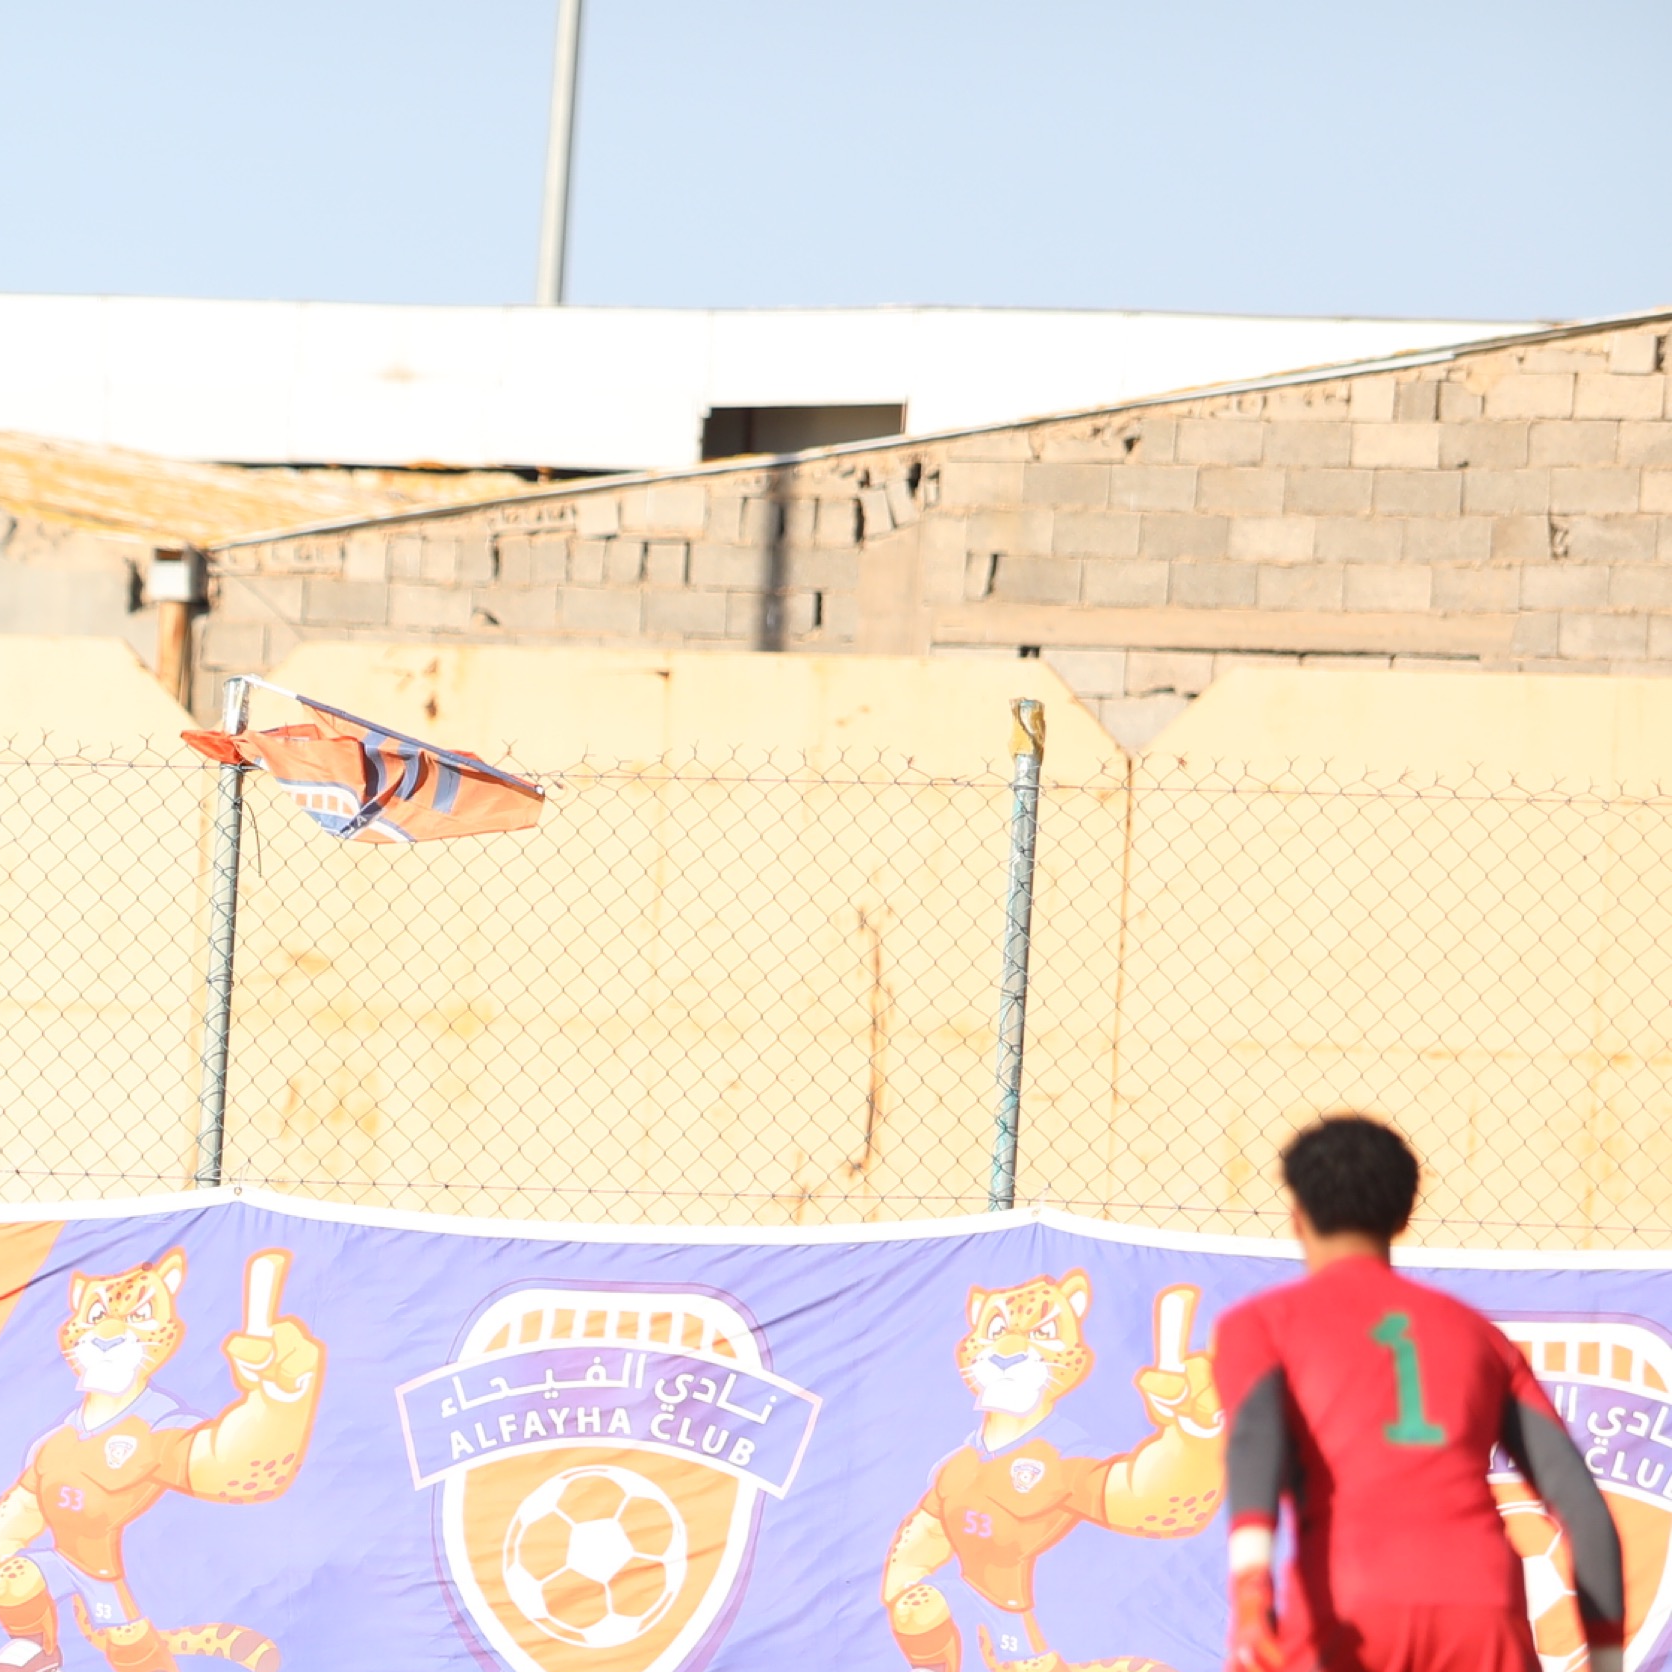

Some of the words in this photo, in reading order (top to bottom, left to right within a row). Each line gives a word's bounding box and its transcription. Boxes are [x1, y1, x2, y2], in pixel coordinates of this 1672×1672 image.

[441, 1352, 648, 1418] الفيحاء
[654, 1372, 778, 1425] نادي
[1371, 1313, 1445, 1446] 1
[449, 1407, 632, 1460] ALFAYHA
[650, 1412, 757, 1467] CLUB
[1587, 1406, 1672, 1449] ادي
[57, 1485, 85, 1512] 53
[962, 1509, 993, 1539] 53
[1000, 1633, 1019, 1653] 53
